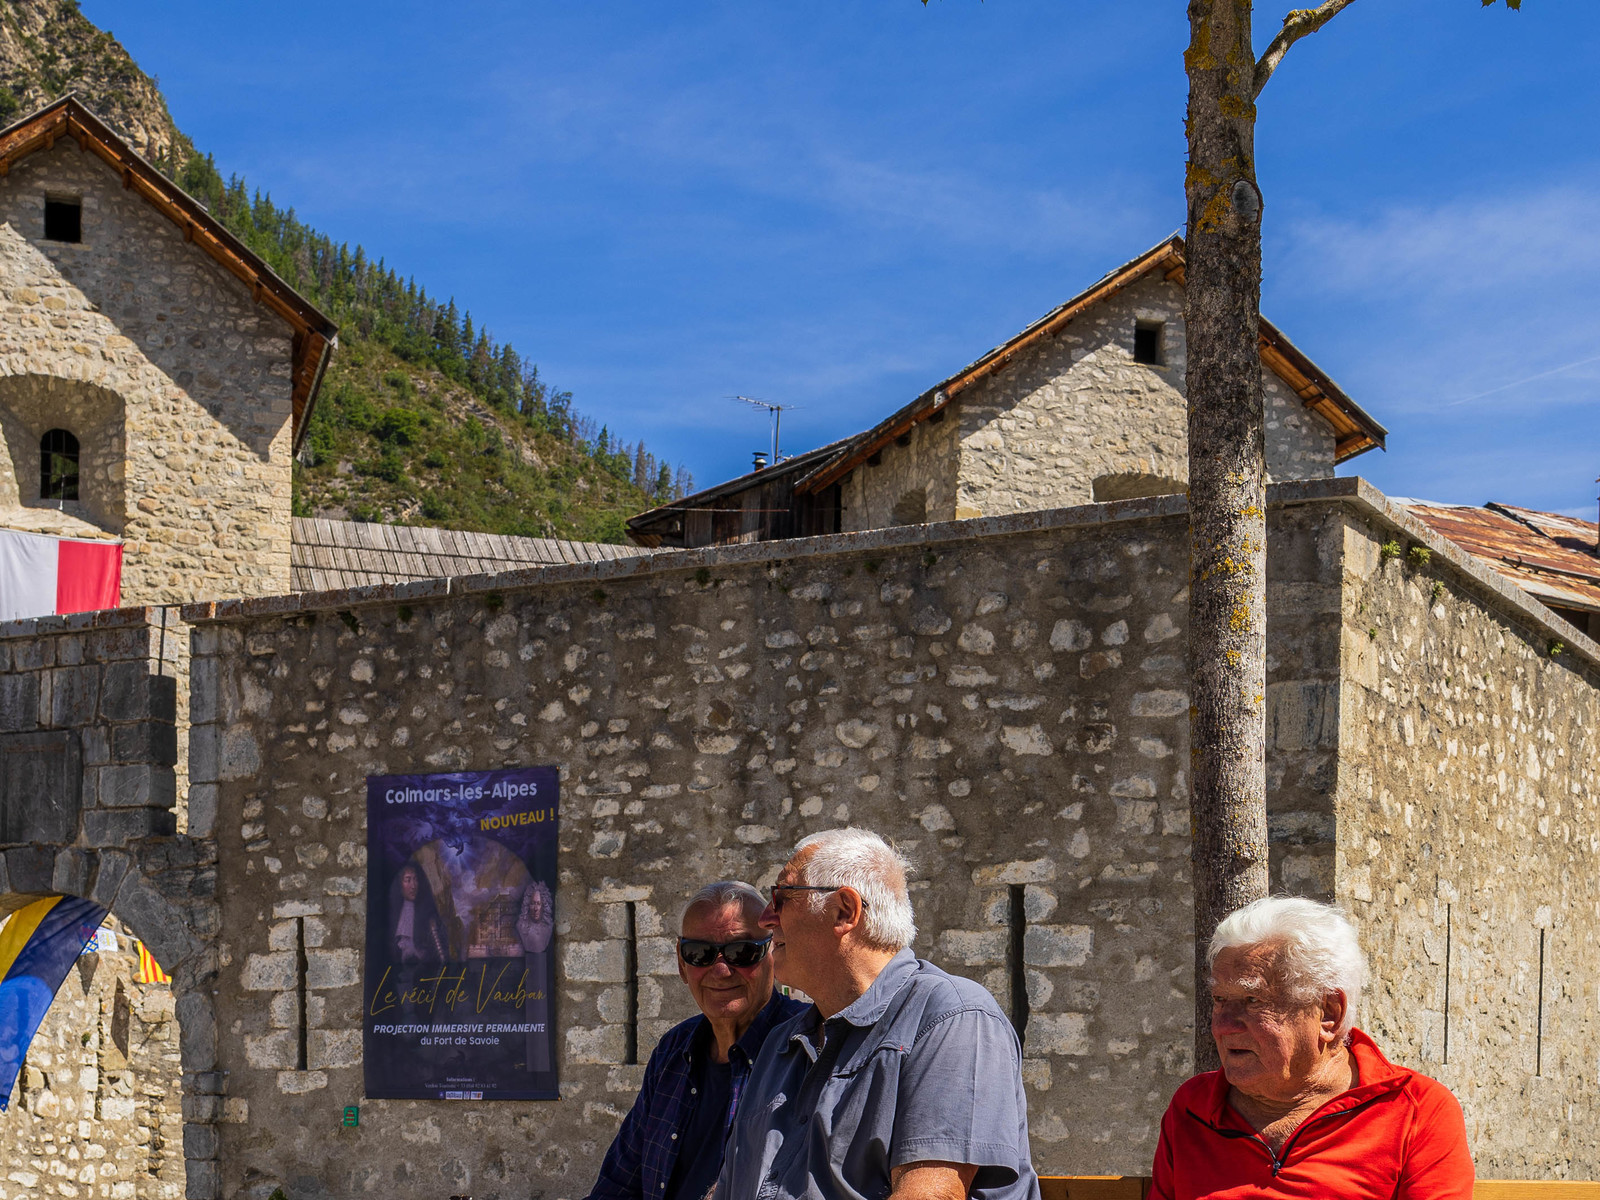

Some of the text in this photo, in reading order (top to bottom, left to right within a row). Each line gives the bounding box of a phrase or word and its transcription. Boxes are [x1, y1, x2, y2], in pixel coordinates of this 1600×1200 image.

[385, 781, 538, 804] Colmars-les-Alpes
[480, 809, 546, 831] NOUVEAU
[370, 962, 546, 1016] Le récit de Vauban
[373, 1023, 546, 1035] PROJECTION IMMERSIVE PERMANENTE
[420, 1036, 500, 1046] du Fort de Savoie
